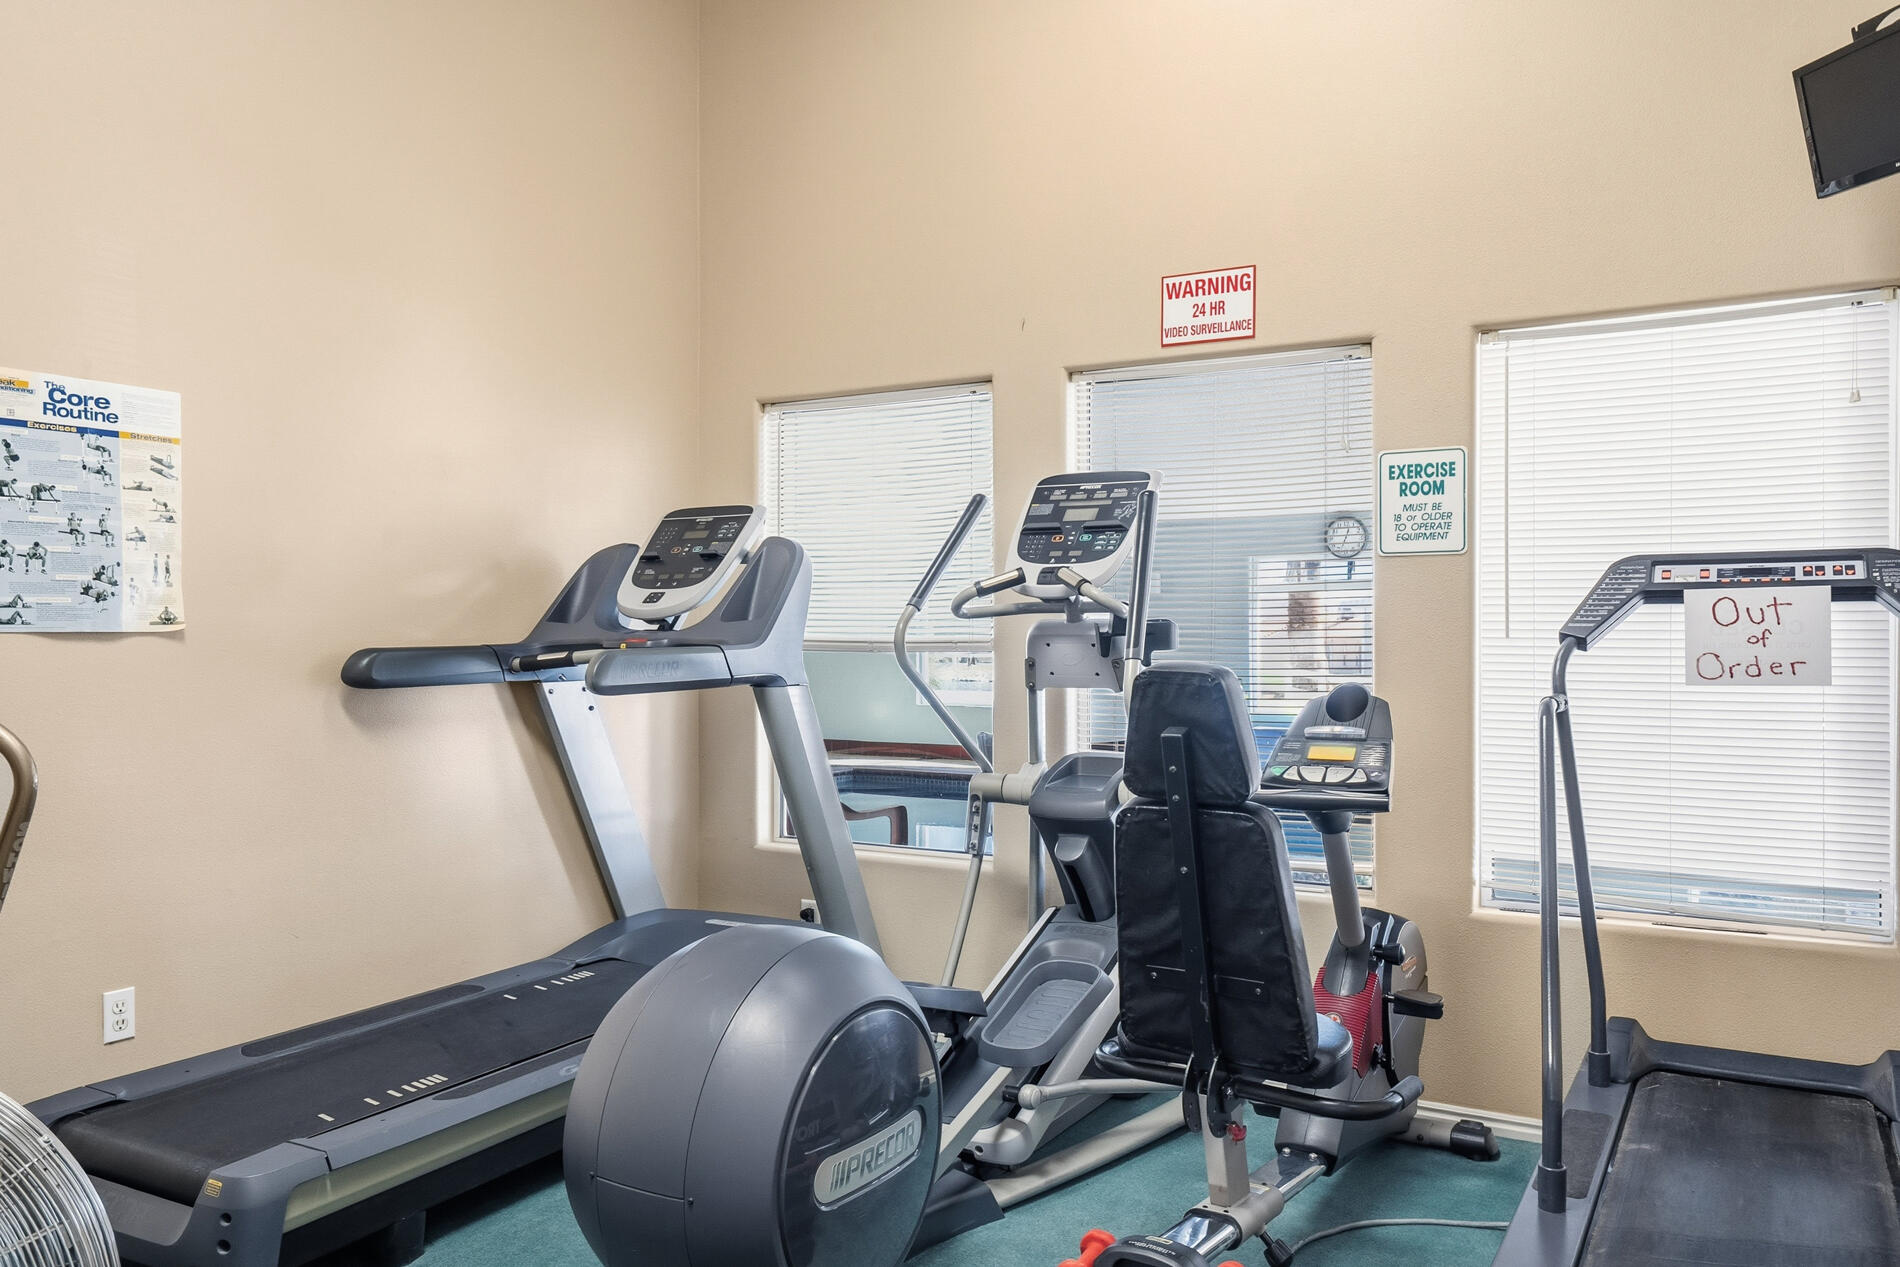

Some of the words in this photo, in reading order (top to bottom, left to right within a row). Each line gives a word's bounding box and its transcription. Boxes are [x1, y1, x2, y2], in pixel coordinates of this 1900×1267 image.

[1165, 273, 1252, 300] WARNING
[1192, 302, 1206, 318] 24
[1209, 300, 1225, 316] HR
[1164, 325, 1188, 338] VIDEO
[1190, 319, 1252, 336] SURVEILLANCE
[43, 380, 66, 391] The
[48, 387, 111, 410] Core
[42, 401, 119, 424] Routine
[27, 421, 77, 433] Exercises
[130, 433, 173, 444] Stretches
[1388, 461, 1456, 481] EXERCISE
[1399, 479, 1445, 497] ROOM
[1402, 503, 1428, 512] MUST
[1431, 502, 1443, 511] BE
[1393, 513, 1402, 522] 18
[1406, 514, 1417, 522] or
[1421, 512, 1453, 521] OLDER
[1394, 523, 1407, 532] TO
[1411, 521, 1452, 531] OPERATE
[1395, 531, 1449, 542] EQUIPMENT
[1711, 596, 1793, 627] Out
[1746, 628, 1772, 648] of
[1696, 652, 1807, 680] Order
[845, 1121, 914, 1184] PRECOR
